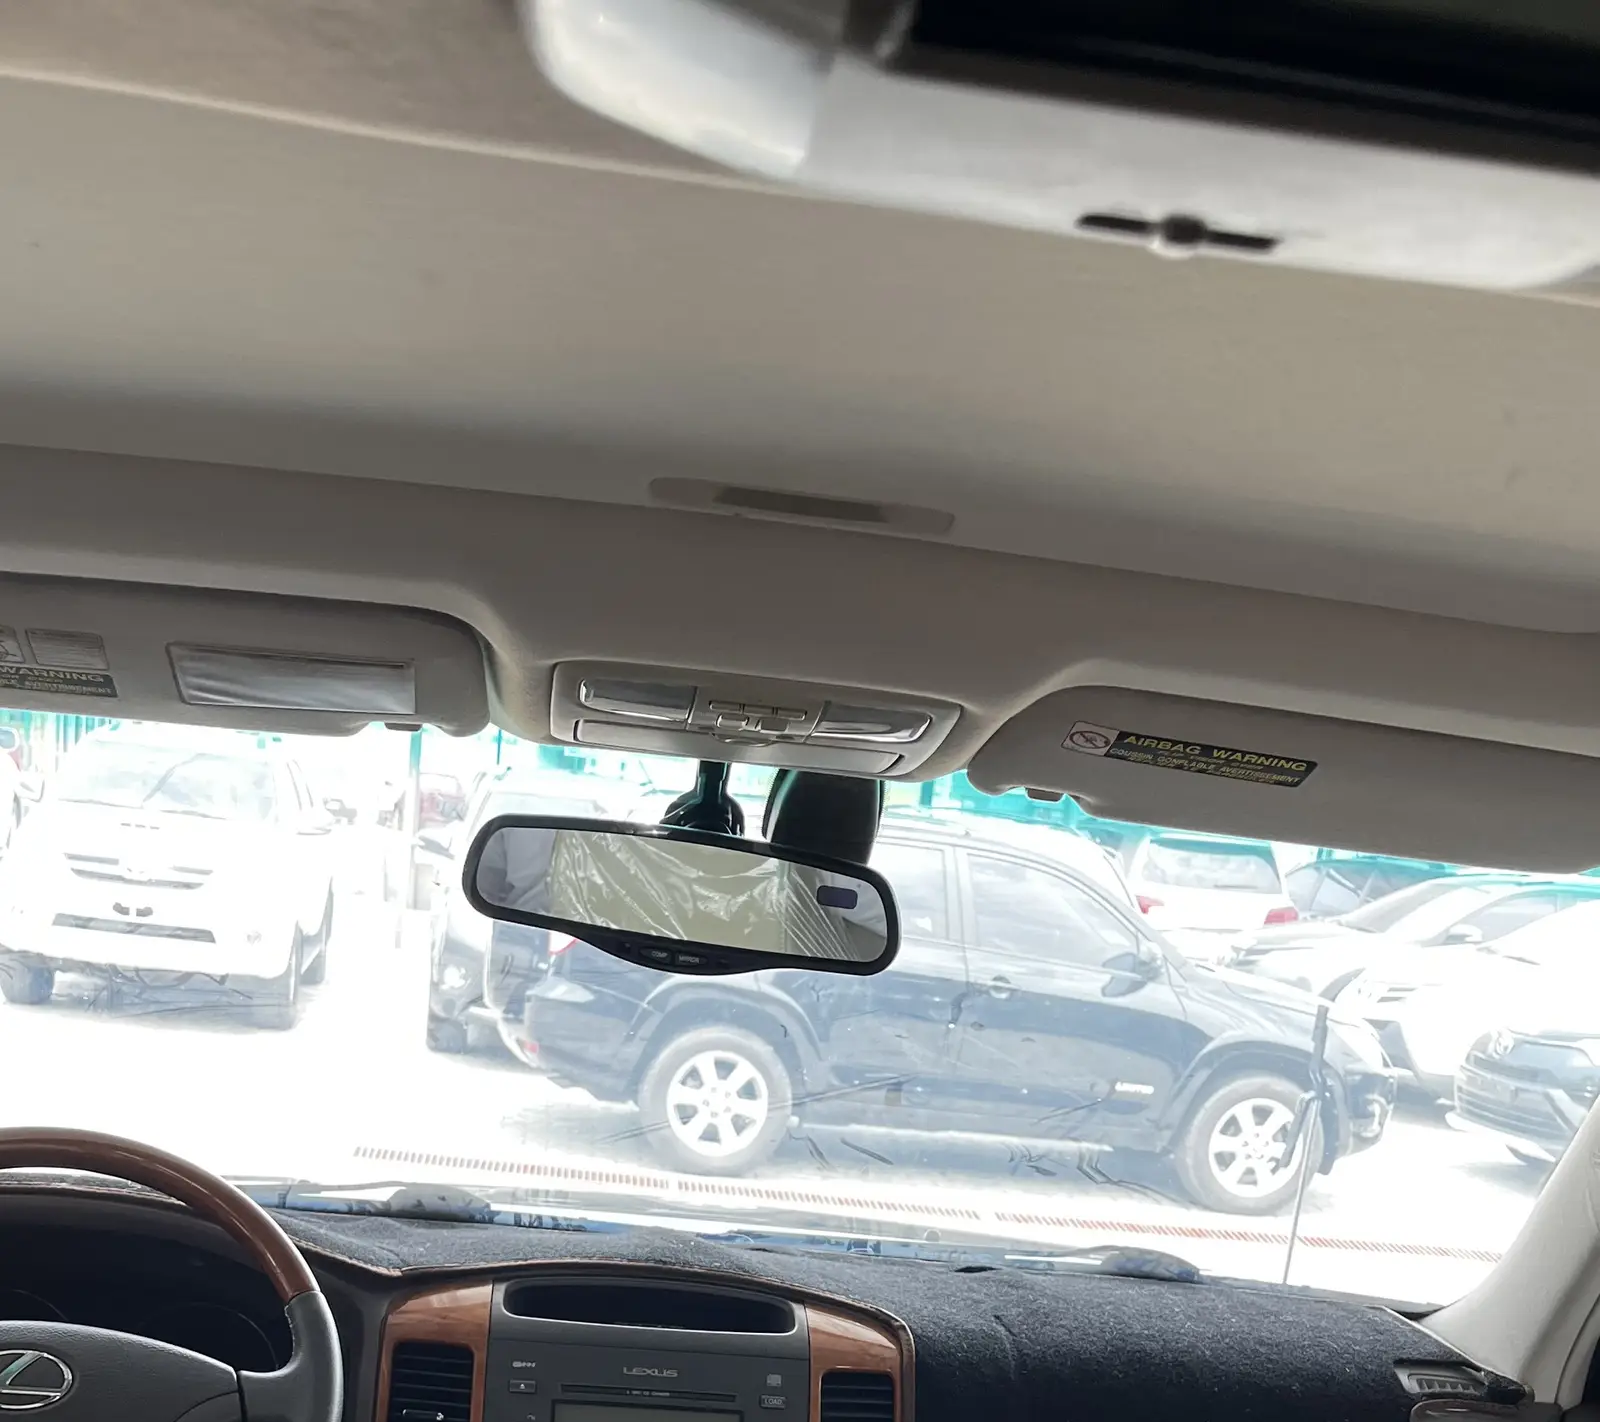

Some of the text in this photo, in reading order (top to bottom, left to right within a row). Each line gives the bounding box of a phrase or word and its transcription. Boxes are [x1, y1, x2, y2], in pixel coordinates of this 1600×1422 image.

[0, 665, 104, 683] WARNING
[1124, 735, 1201, 755] AIRBAG
[1213, 749, 1308, 771] WARNING
[623, 1366, 679, 1378] LEXUS
